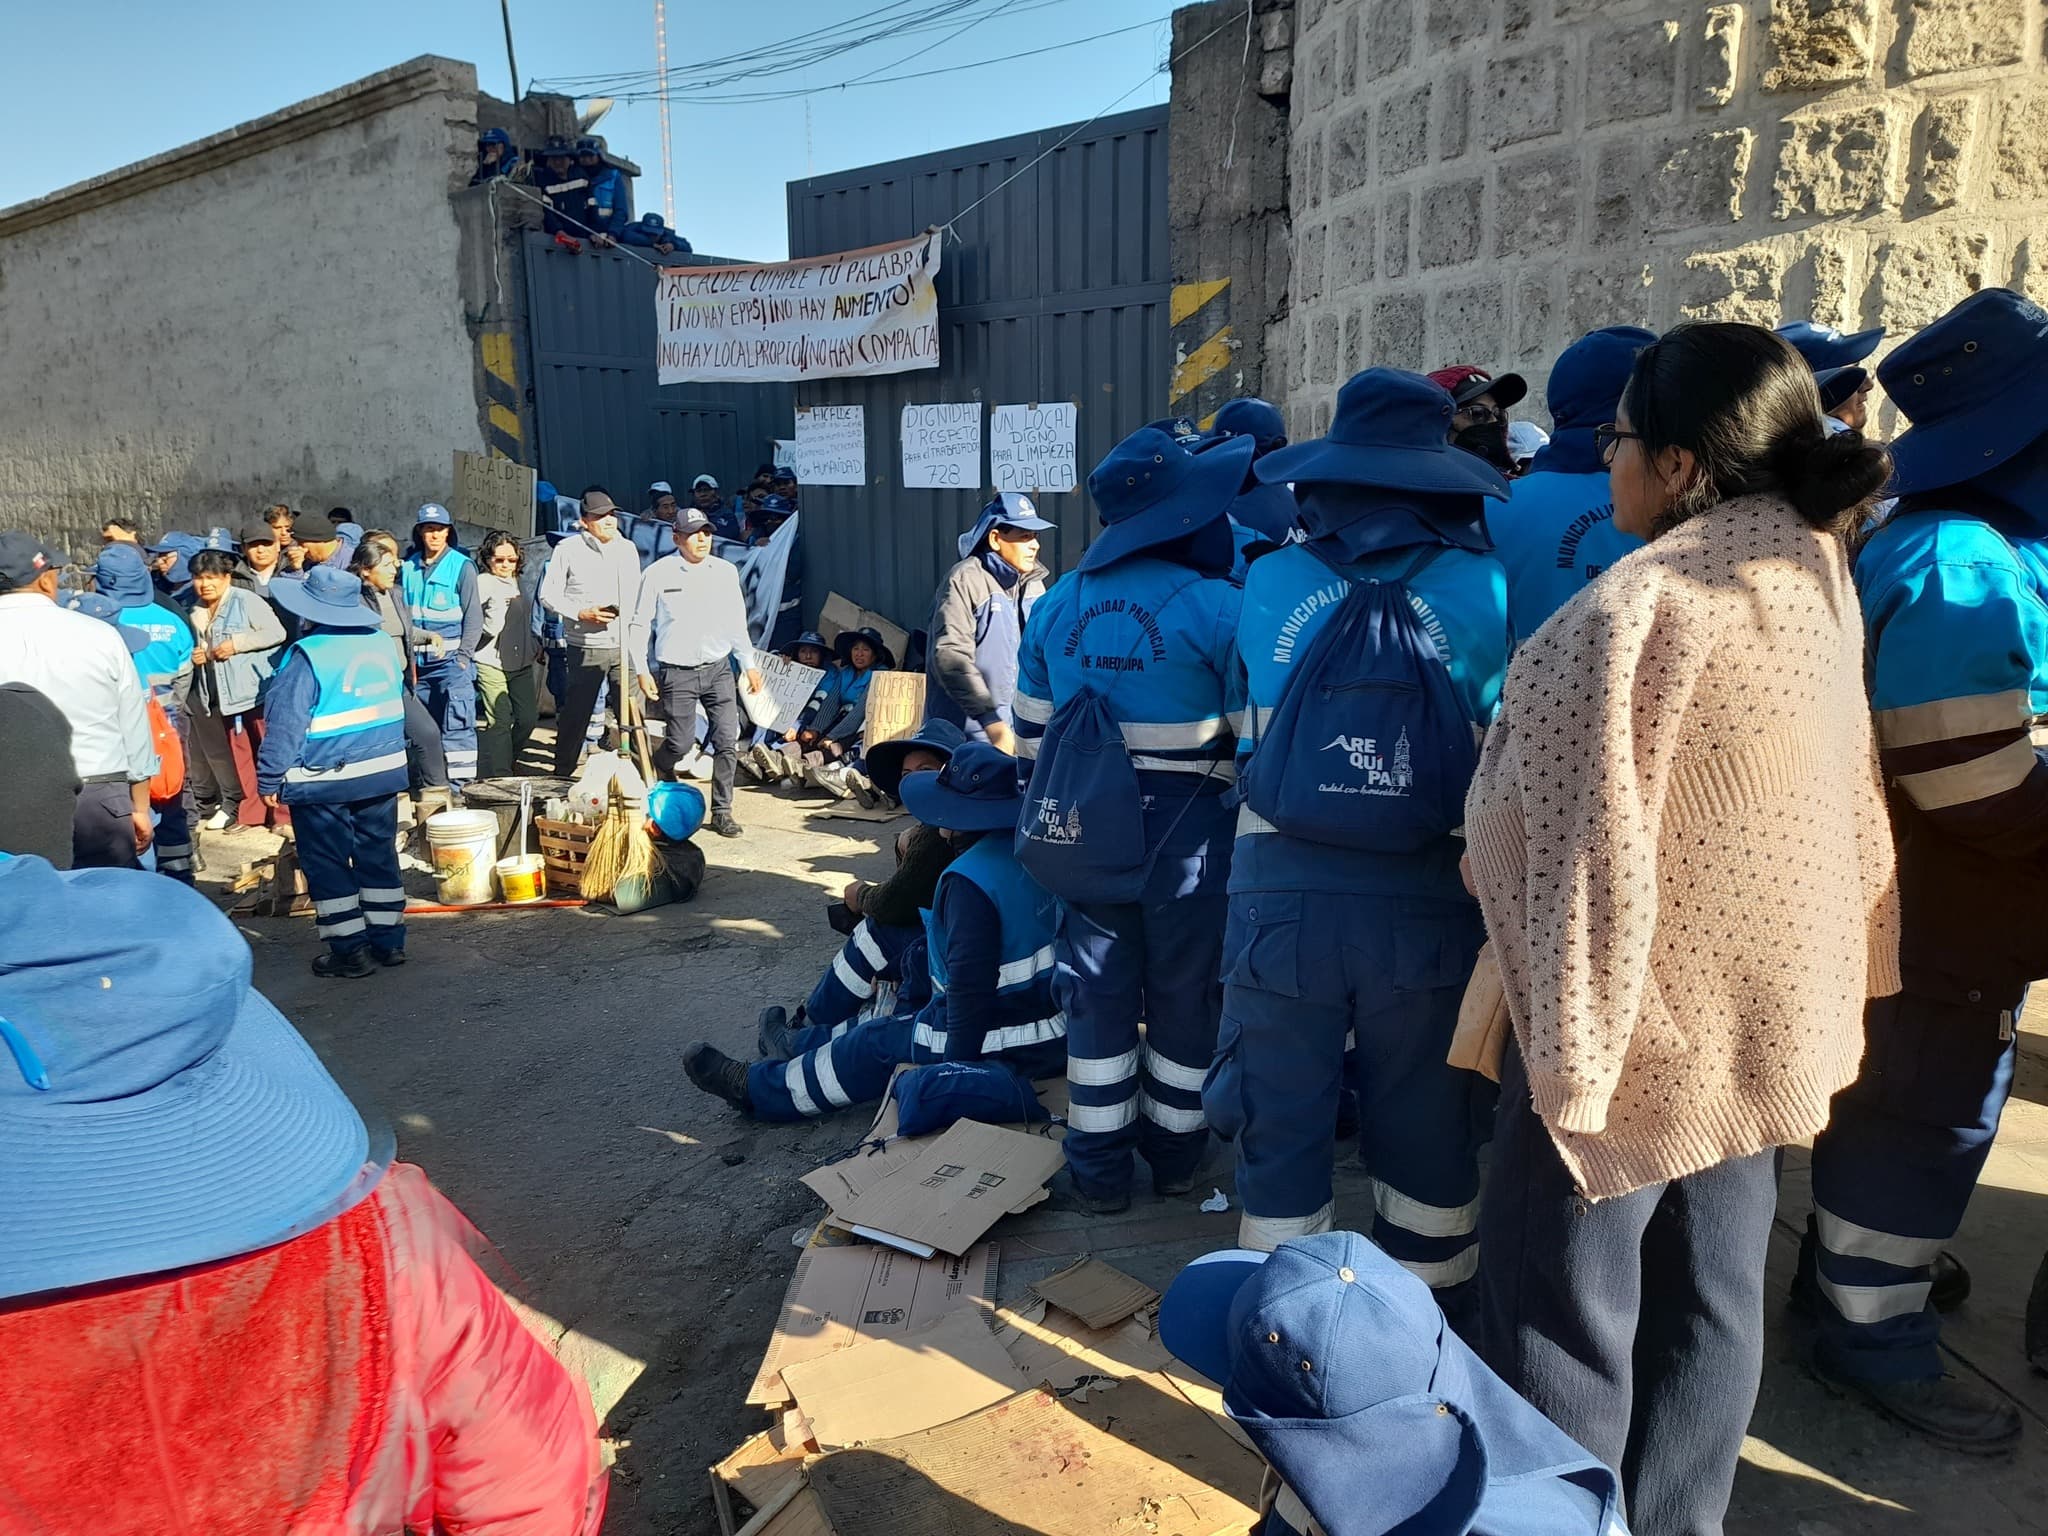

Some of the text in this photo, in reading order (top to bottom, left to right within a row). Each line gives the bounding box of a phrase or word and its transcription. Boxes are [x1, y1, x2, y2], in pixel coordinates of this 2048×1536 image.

[750, 268, 808, 292] CUMPLE
[703, 303, 726, 329] HAY
[800, 297, 826, 321] HAY
[682, 341, 712, 368] HAY
[714, 340, 754, 368] LOCAL
[829, 335, 855, 368] HAY
[993, 406, 1071, 433] UN LOCAL
[463, 454, 522, 485] ALCALDE
[924, 463, 961, 486] 728
[1556, 503, 1615, 569] MUNICIPALI
[1064, 599, 1168, 664] MUNICIPALIDAD PROVINCIAL
[1095, 655, 1144, 672] AREQUIPA
